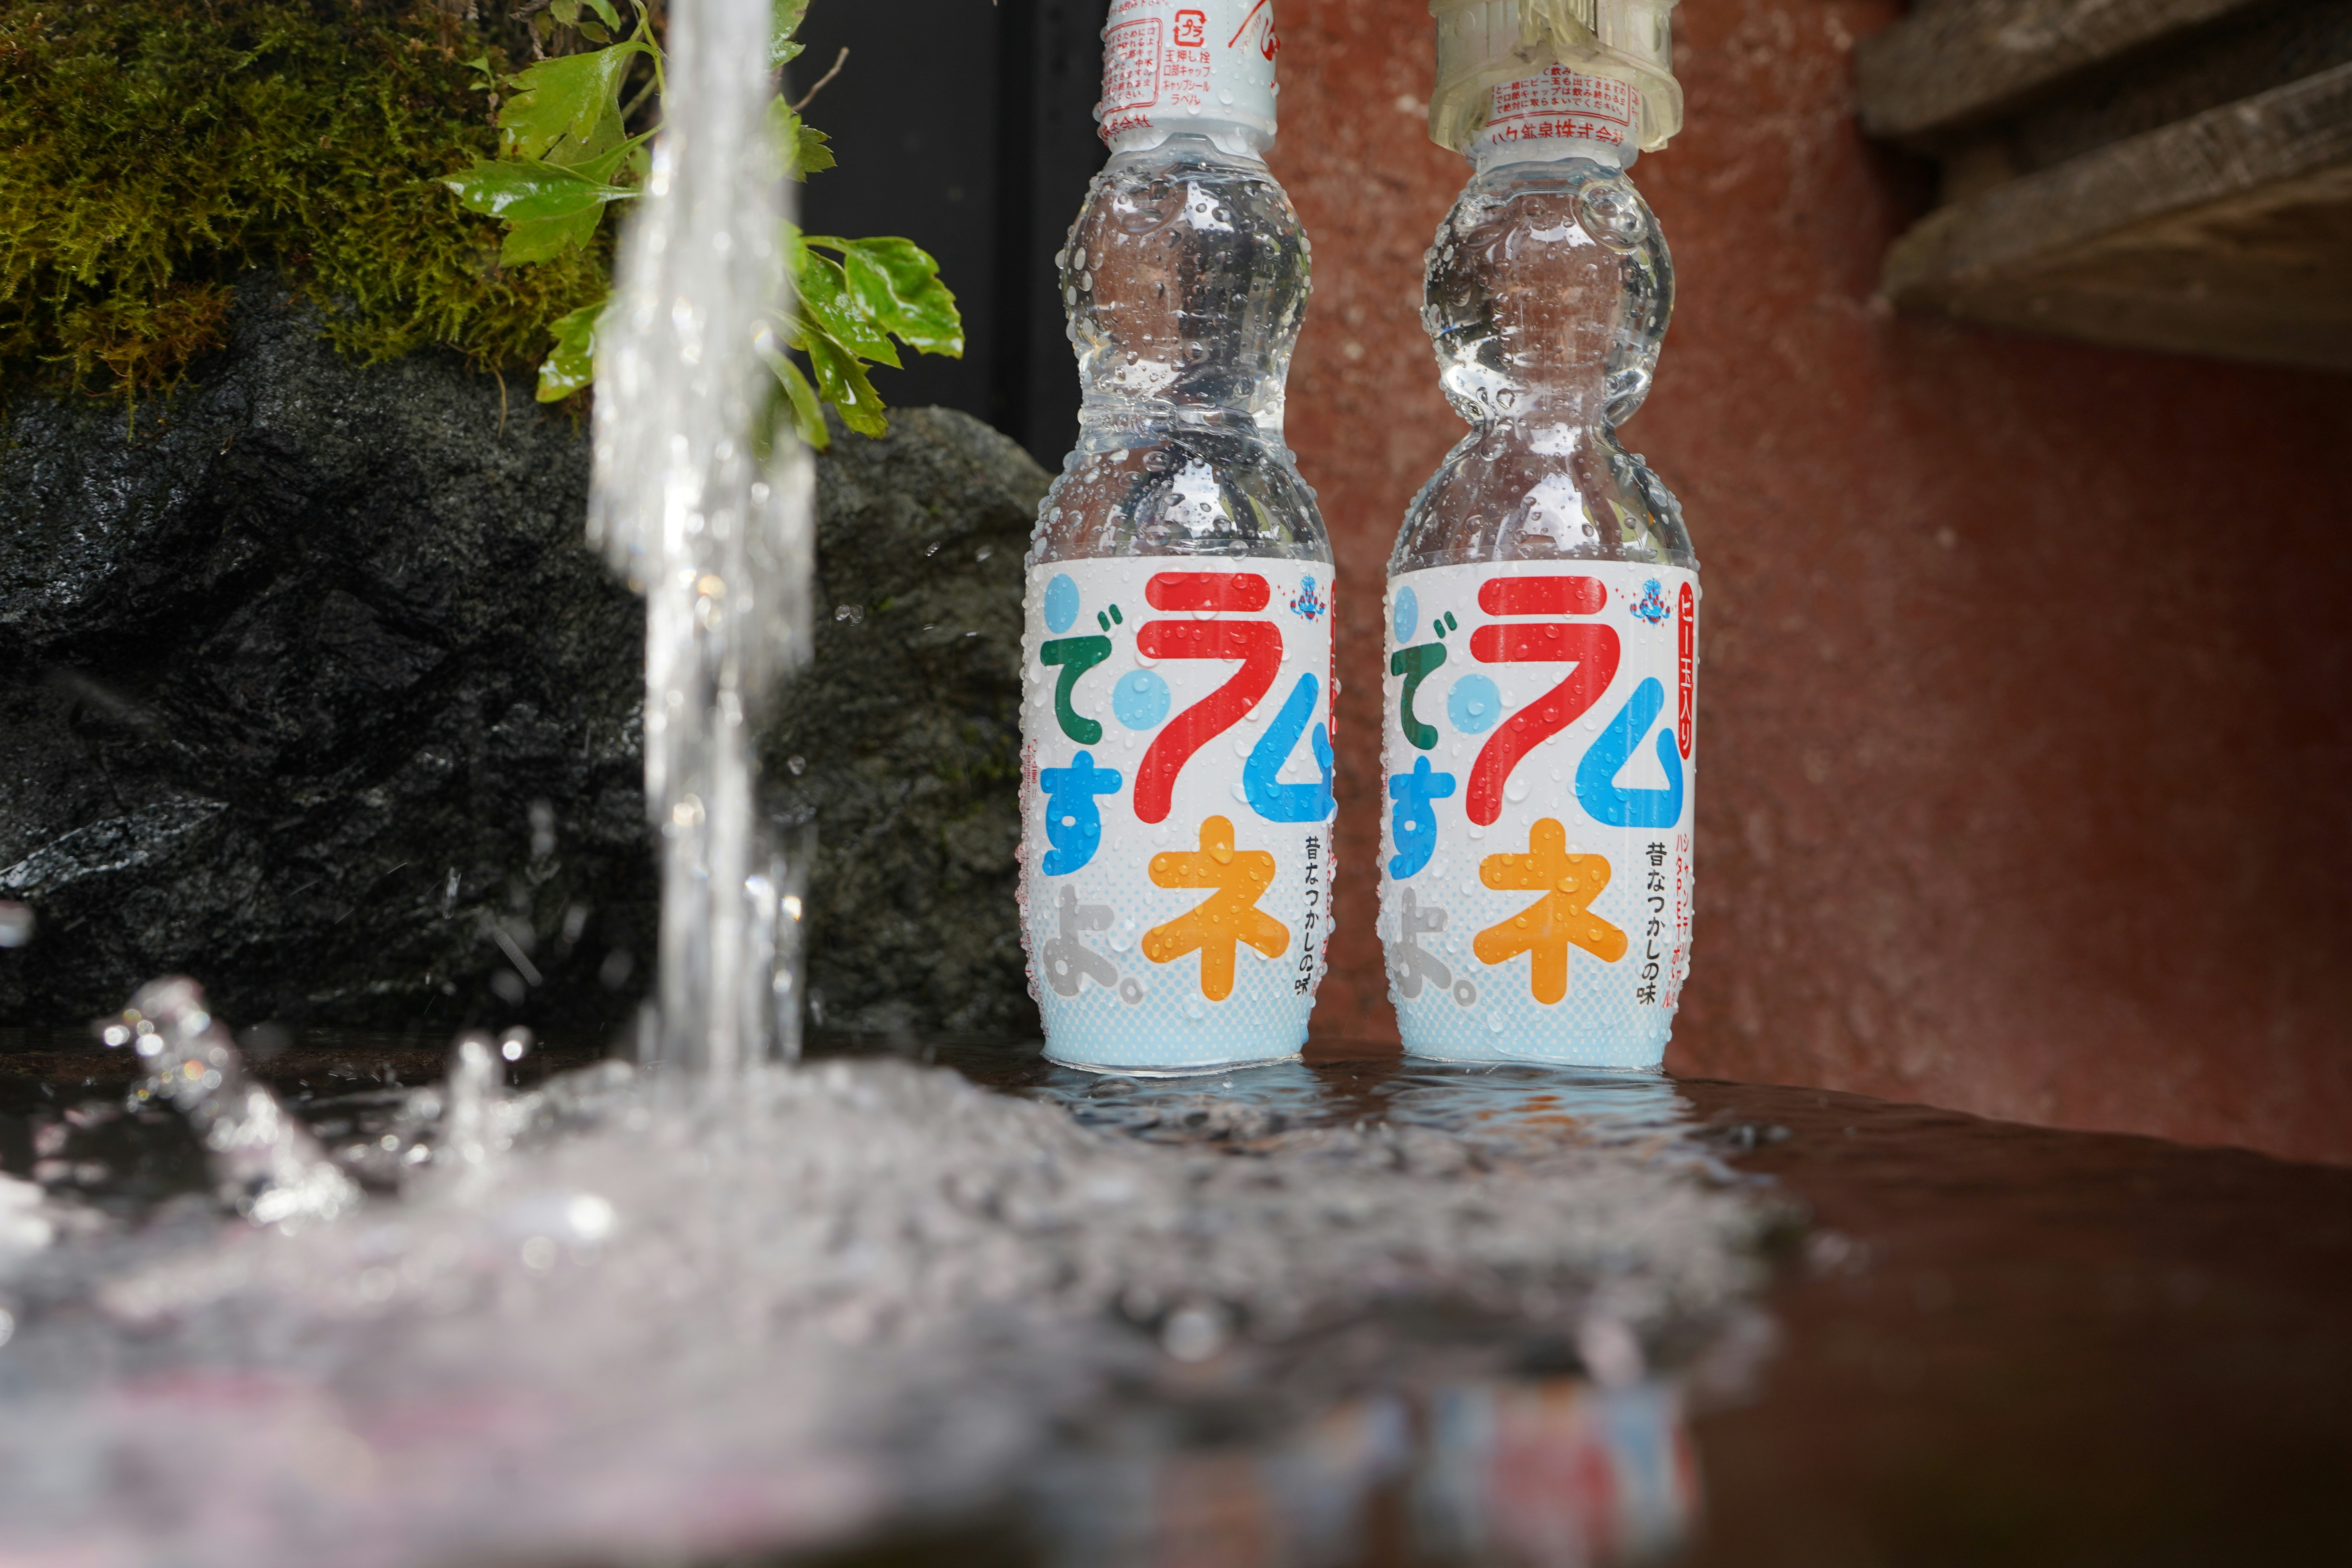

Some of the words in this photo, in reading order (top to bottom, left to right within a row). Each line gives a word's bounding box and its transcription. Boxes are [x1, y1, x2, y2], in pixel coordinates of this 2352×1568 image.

[1181, 19, 1203, 37] プラ
[1164, 50, 1210, 63] 玉押し栓
[1163, 64, 1210, 76] 口部キャップ
[1163, 79, 1210, 92] キャップシール
[1171, 94, 1201, 105] ラベル
[1680, 593, 1693, 750] ビー玉入り
[1295, 835, 1320, 995] 昔なつかしの味
[1637, 842, 1667, 1005] 昔なつかしの味
[1662, 834, 1683, 1008] ハタPETボトル
